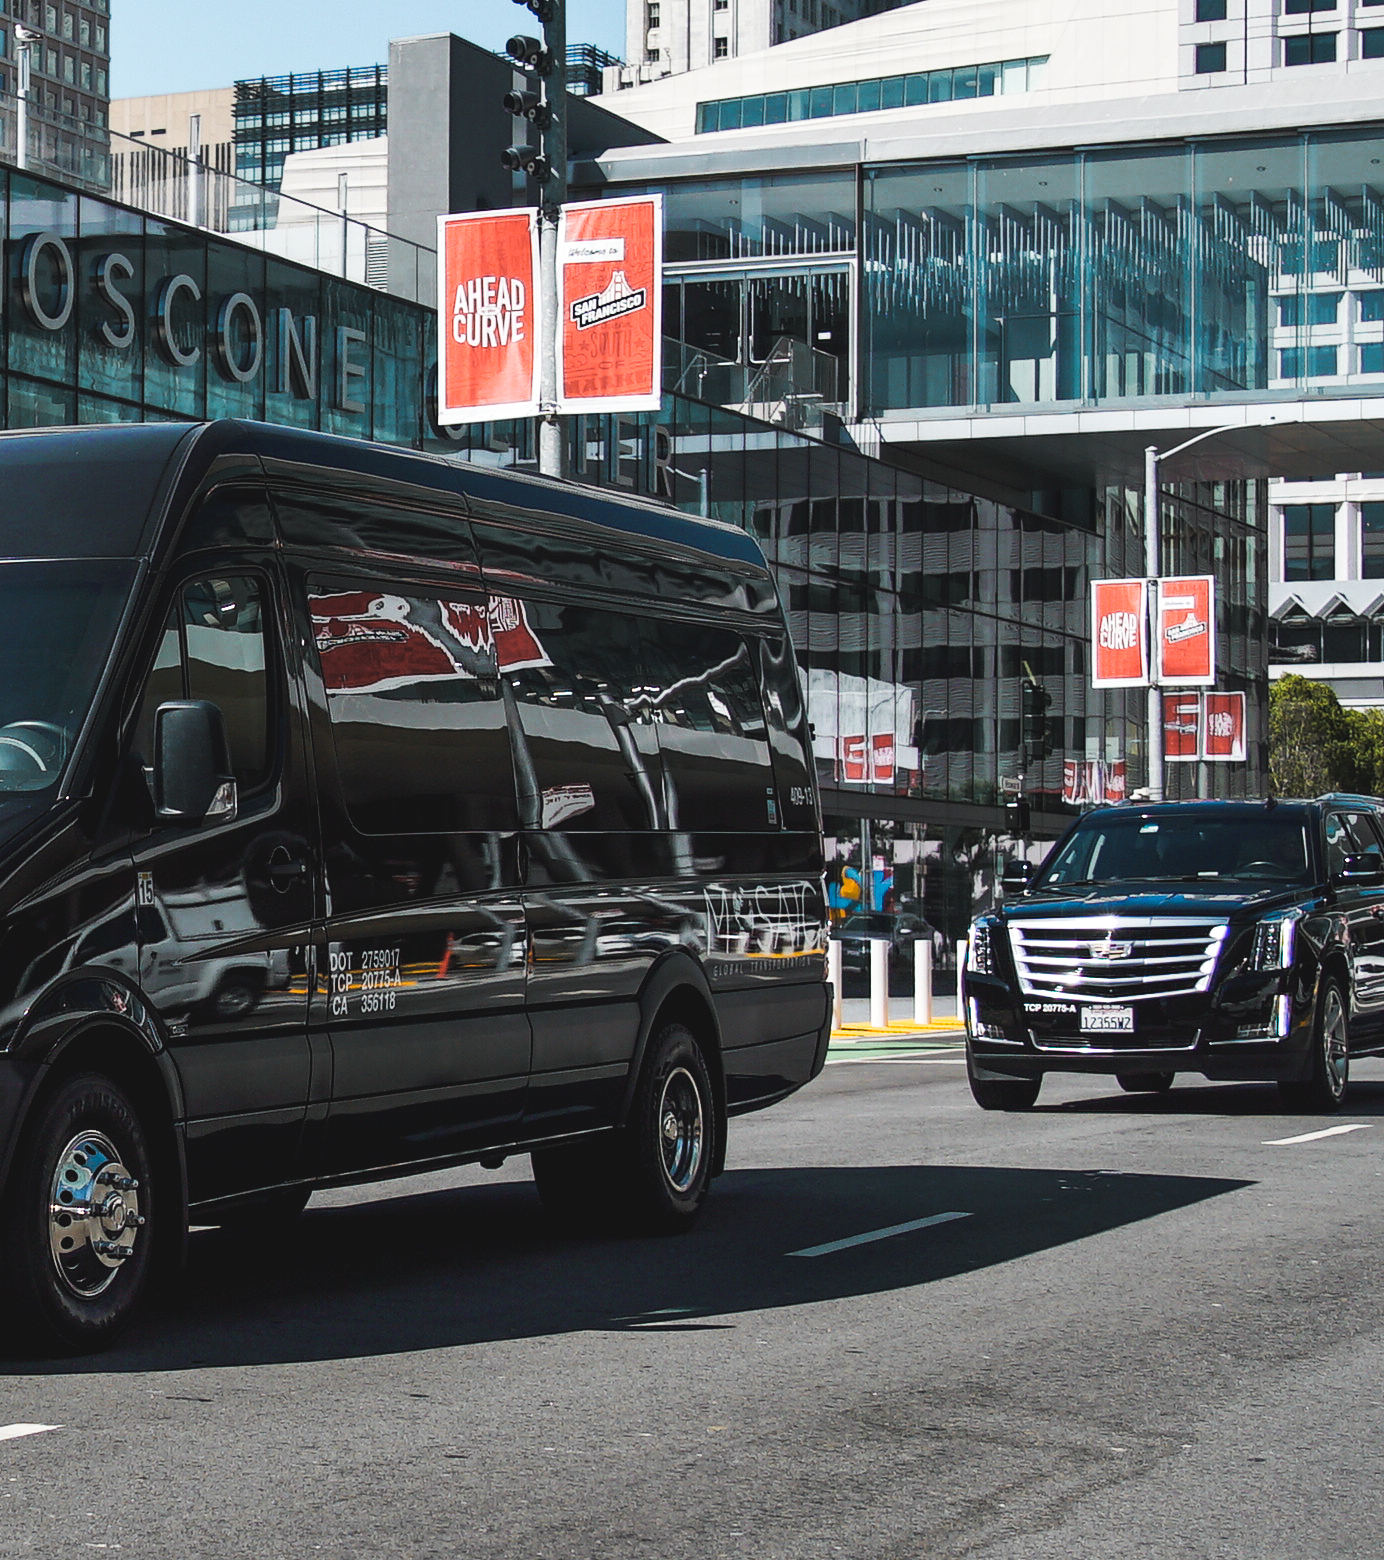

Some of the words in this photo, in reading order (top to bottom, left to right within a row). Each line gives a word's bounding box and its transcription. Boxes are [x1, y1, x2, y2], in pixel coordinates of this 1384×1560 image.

[453, 275, 525, 315] AHEAD
[574, 298, 597, 316] SAN
[581, 294, 642, 325] FRANCISCO
[452, 310, 525, 348] CURVE
[1100, 611, 1137, 633] AHEAD
[1099, 630, 1137, 650] CURVE
[139, 880, 153, 903] 15
[330, 952, 353, 972] DOT
[361, 948, 400, 970] 2759017
[331, 973, 353, 993] TCP
[361, 969, 402, 990] 20775-A
[332, 996, 348, 1015] CA
[360, 991, 396, 1013] 356118
[1024, 1003, 1042, 1013] TCP
